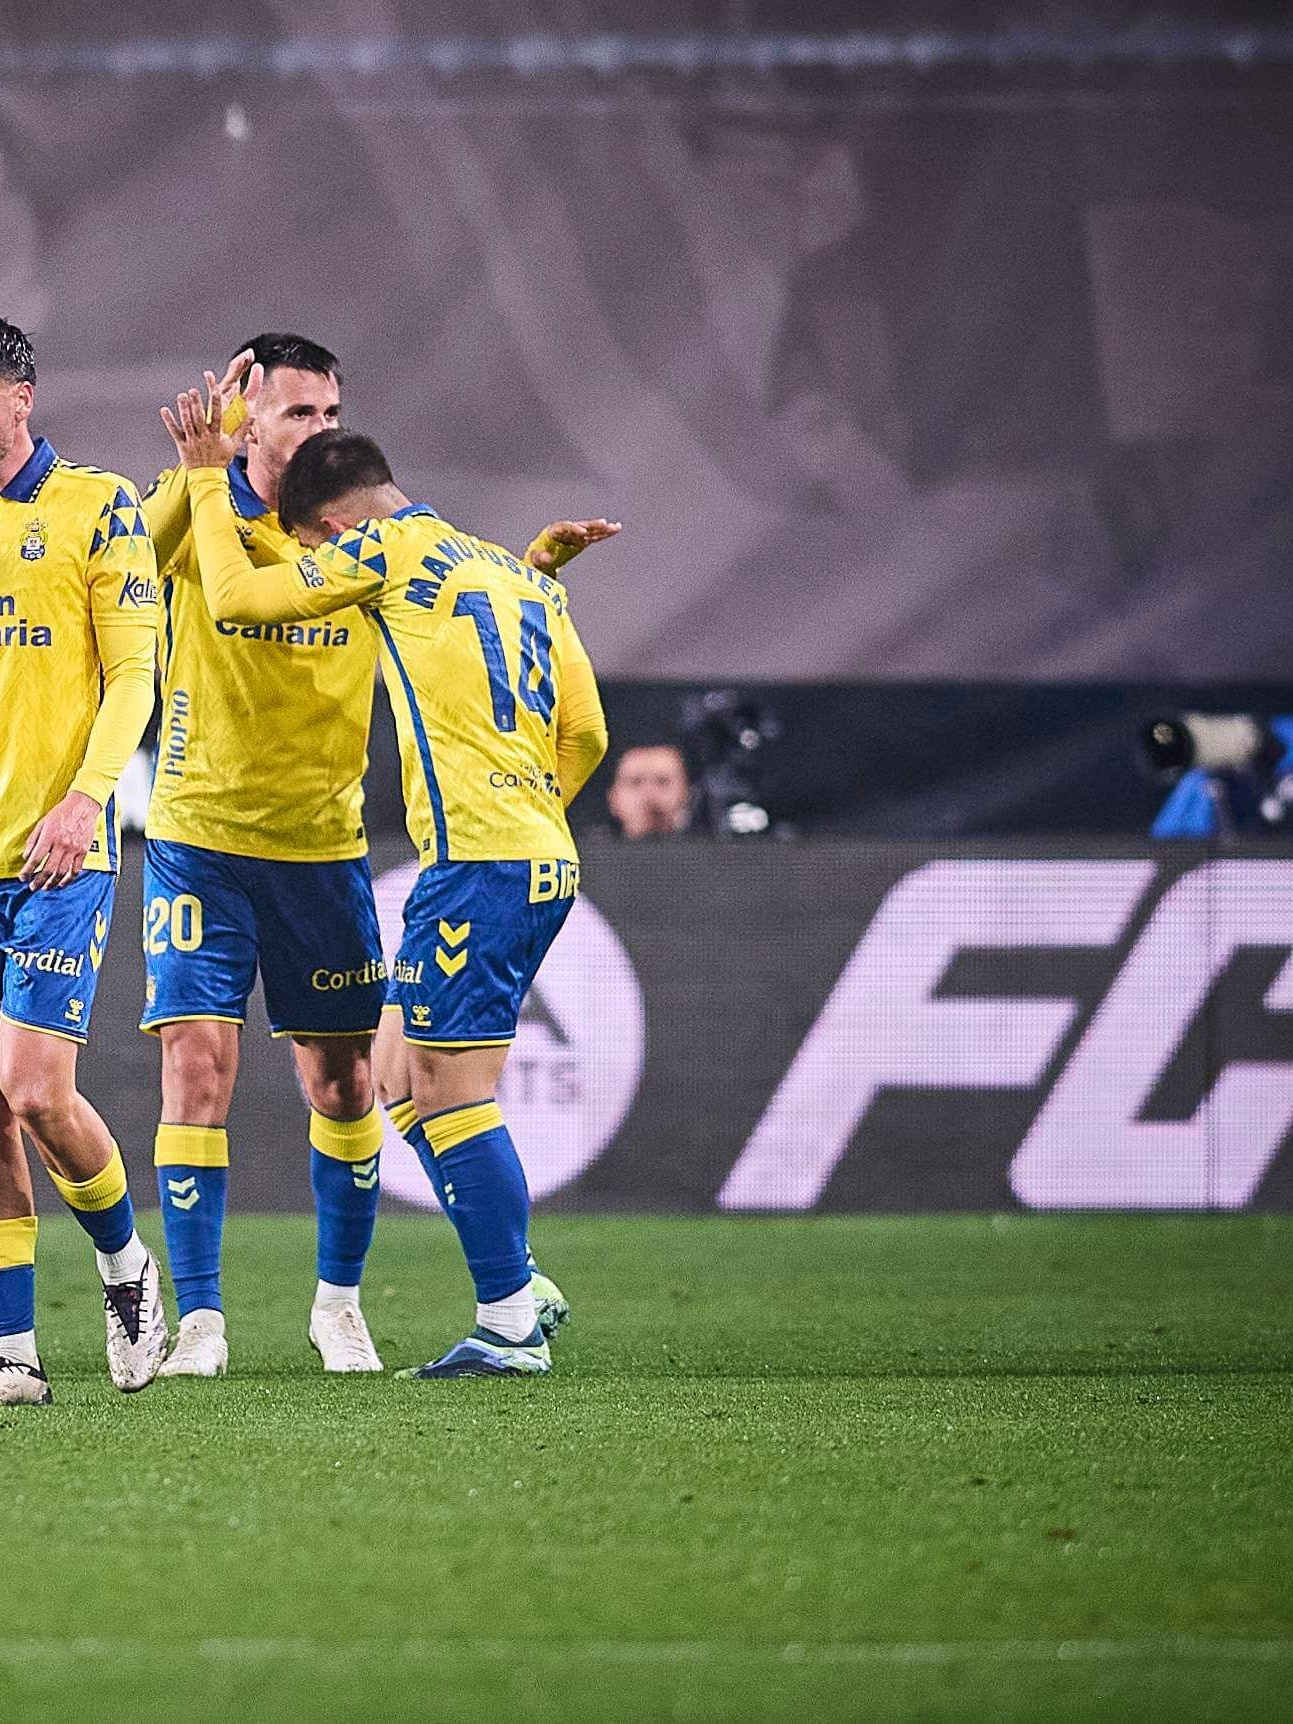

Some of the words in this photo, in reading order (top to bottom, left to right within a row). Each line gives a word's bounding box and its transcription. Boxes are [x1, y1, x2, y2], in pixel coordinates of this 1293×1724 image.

[452, 591, 556, 737] 14
[147, 893, 203, 956] 20
[717, 857, 1293, 1210] FC
